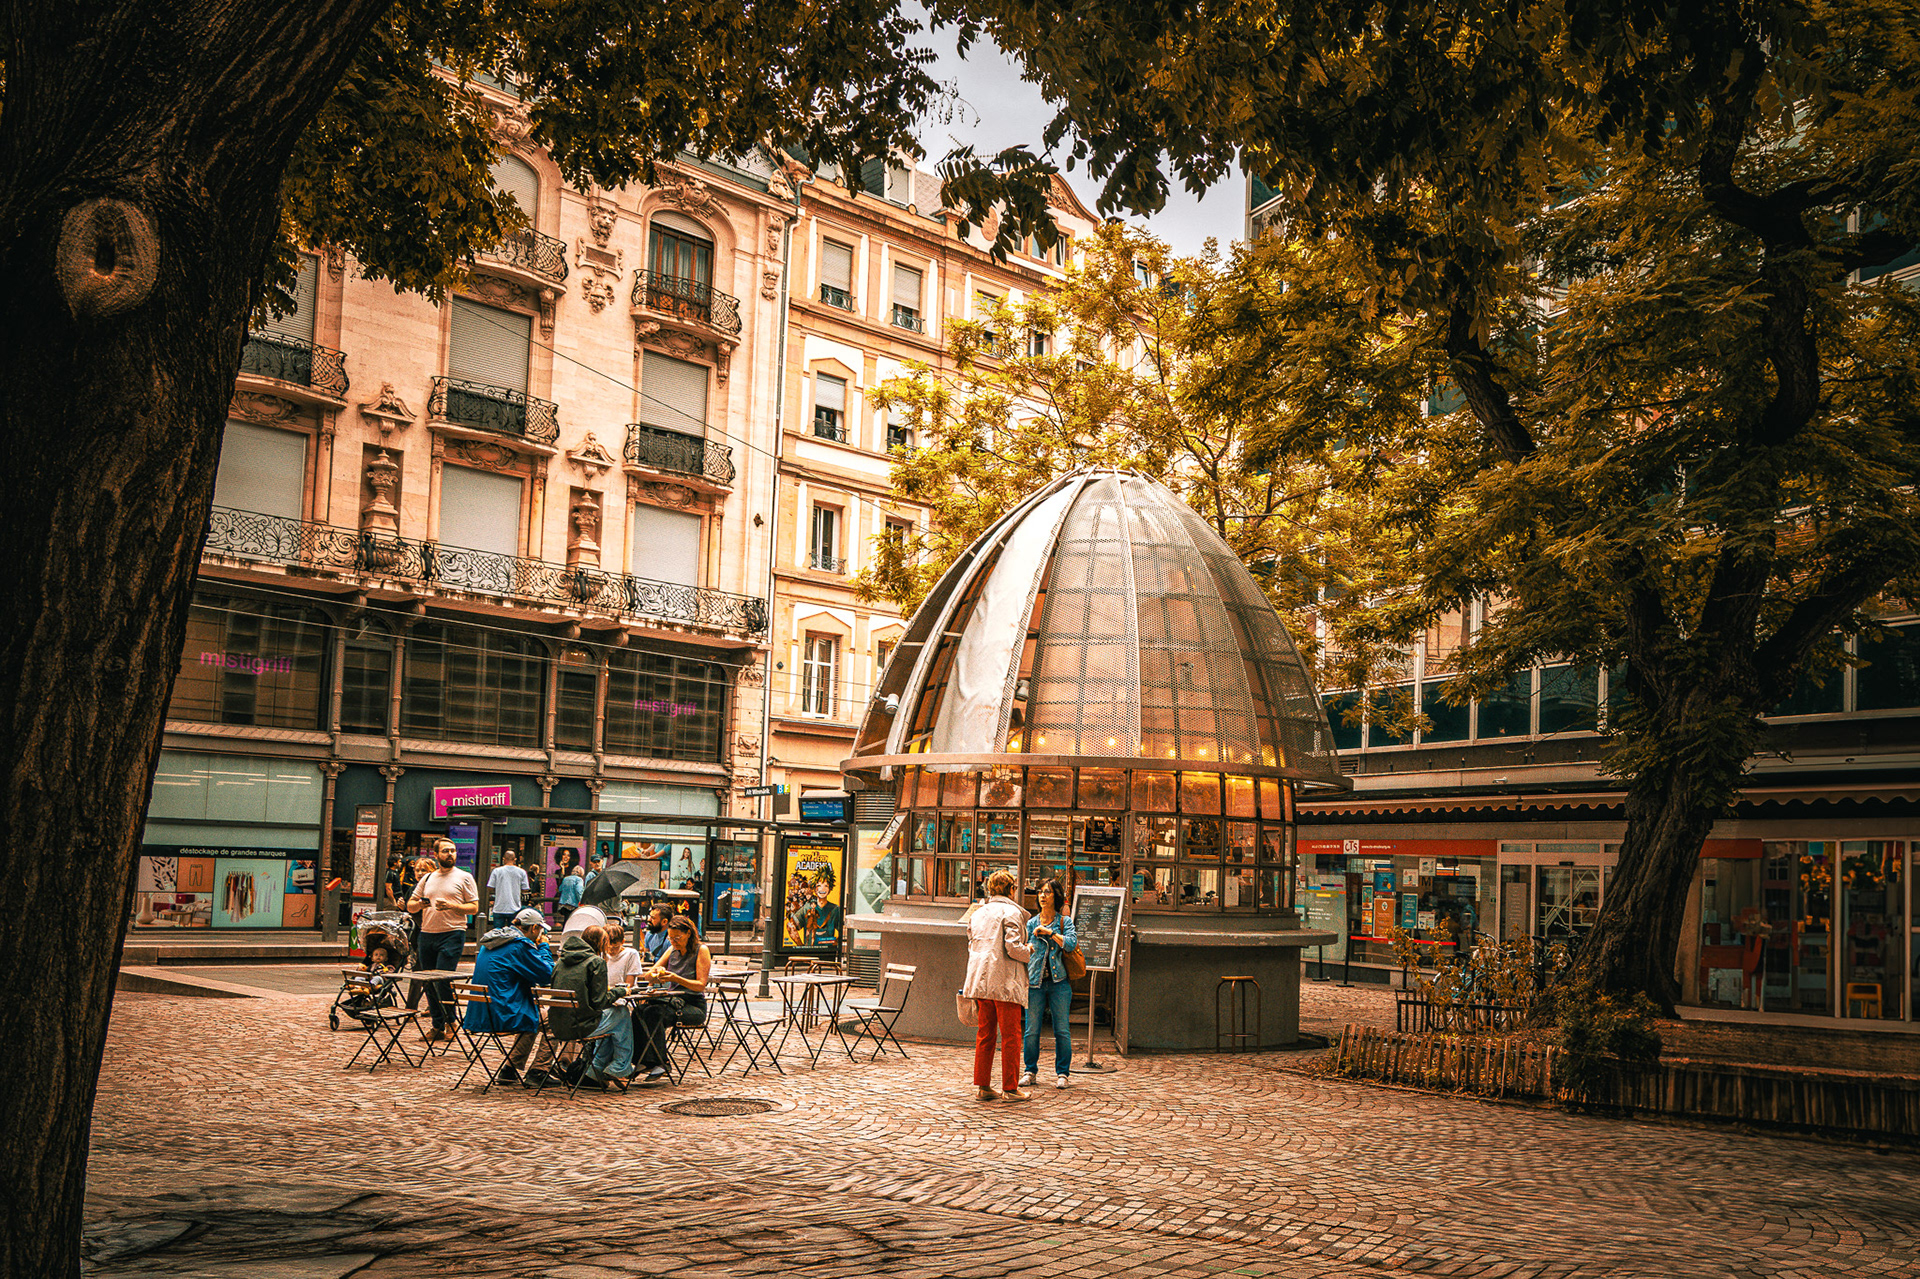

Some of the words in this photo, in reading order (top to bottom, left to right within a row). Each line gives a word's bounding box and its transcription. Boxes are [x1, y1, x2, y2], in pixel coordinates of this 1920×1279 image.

[200, 650, 292, 675] mistigriff
[634, 697, 698, 718] mistigriff
[180, 847, 219, 856] déstockage
[230, 849, 257, 857] grandes
[258, 850, 286, 858] marques
[1344, 841, 1358, 852] CTS
